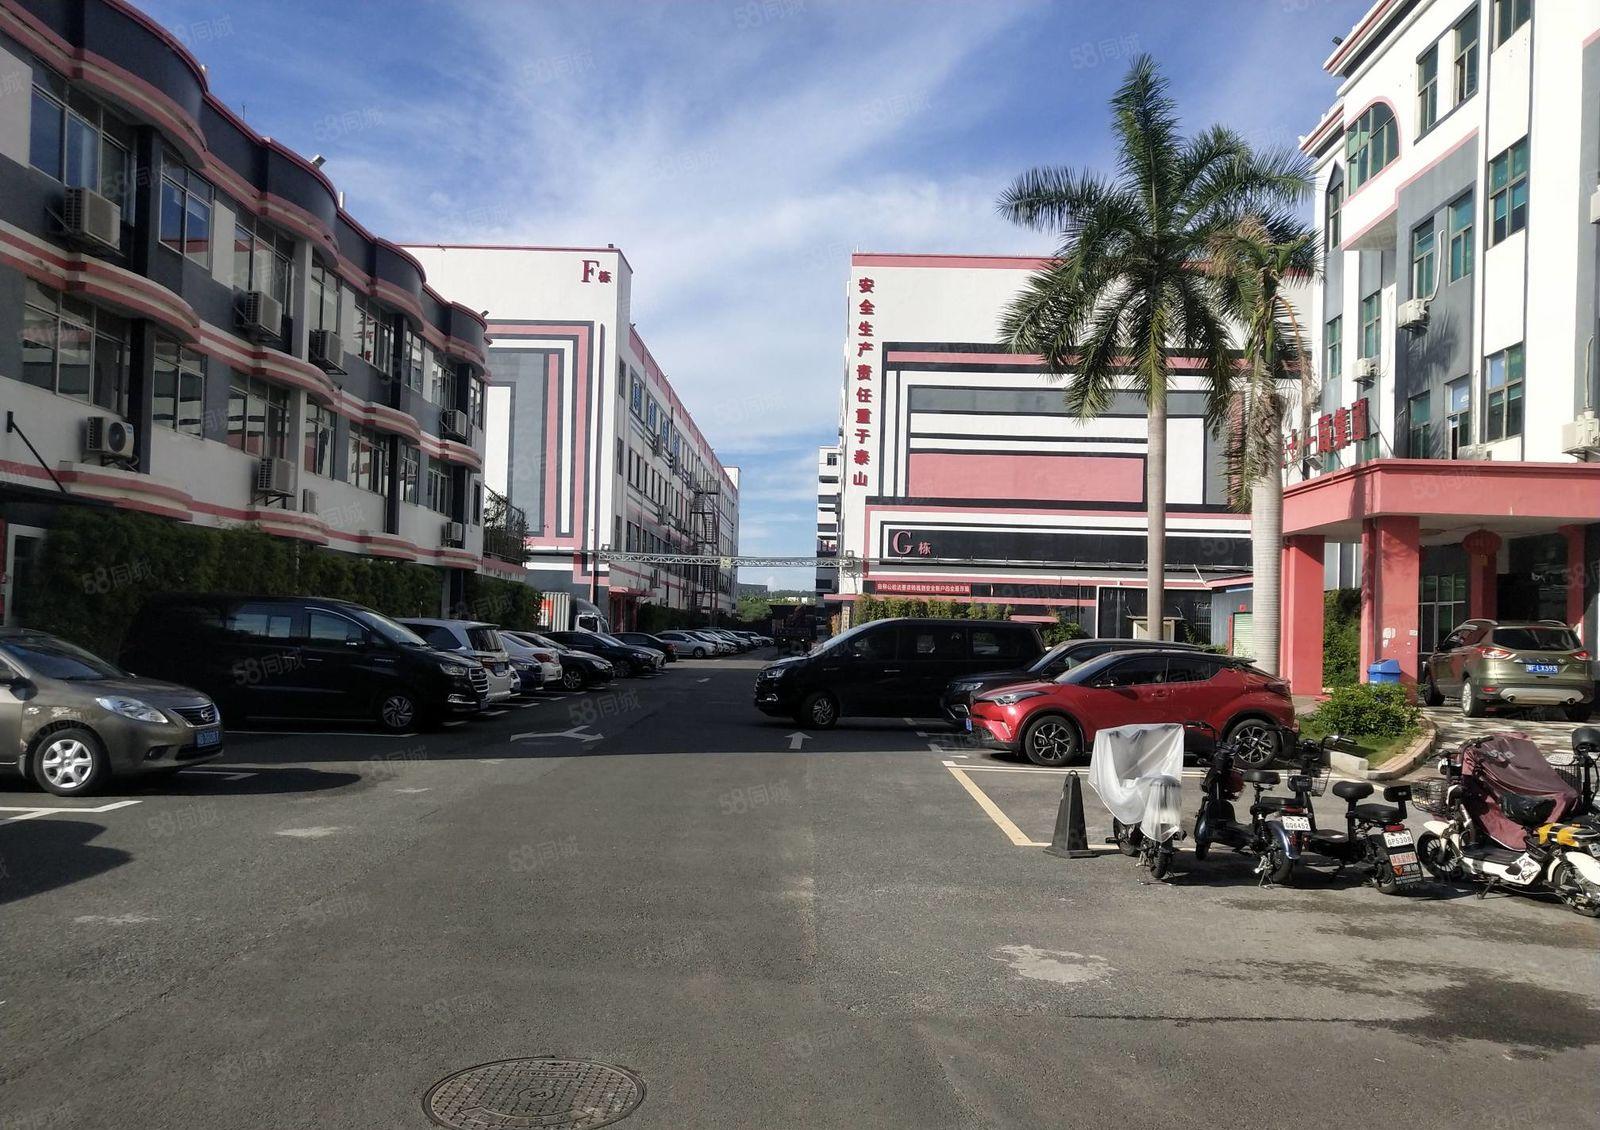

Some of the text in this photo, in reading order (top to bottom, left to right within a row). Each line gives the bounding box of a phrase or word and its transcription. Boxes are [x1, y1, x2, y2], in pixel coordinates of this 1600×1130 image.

[853, 277, 876, 487] 安全生产责任重于泰山
[892, 530, 932, 555] G栋
